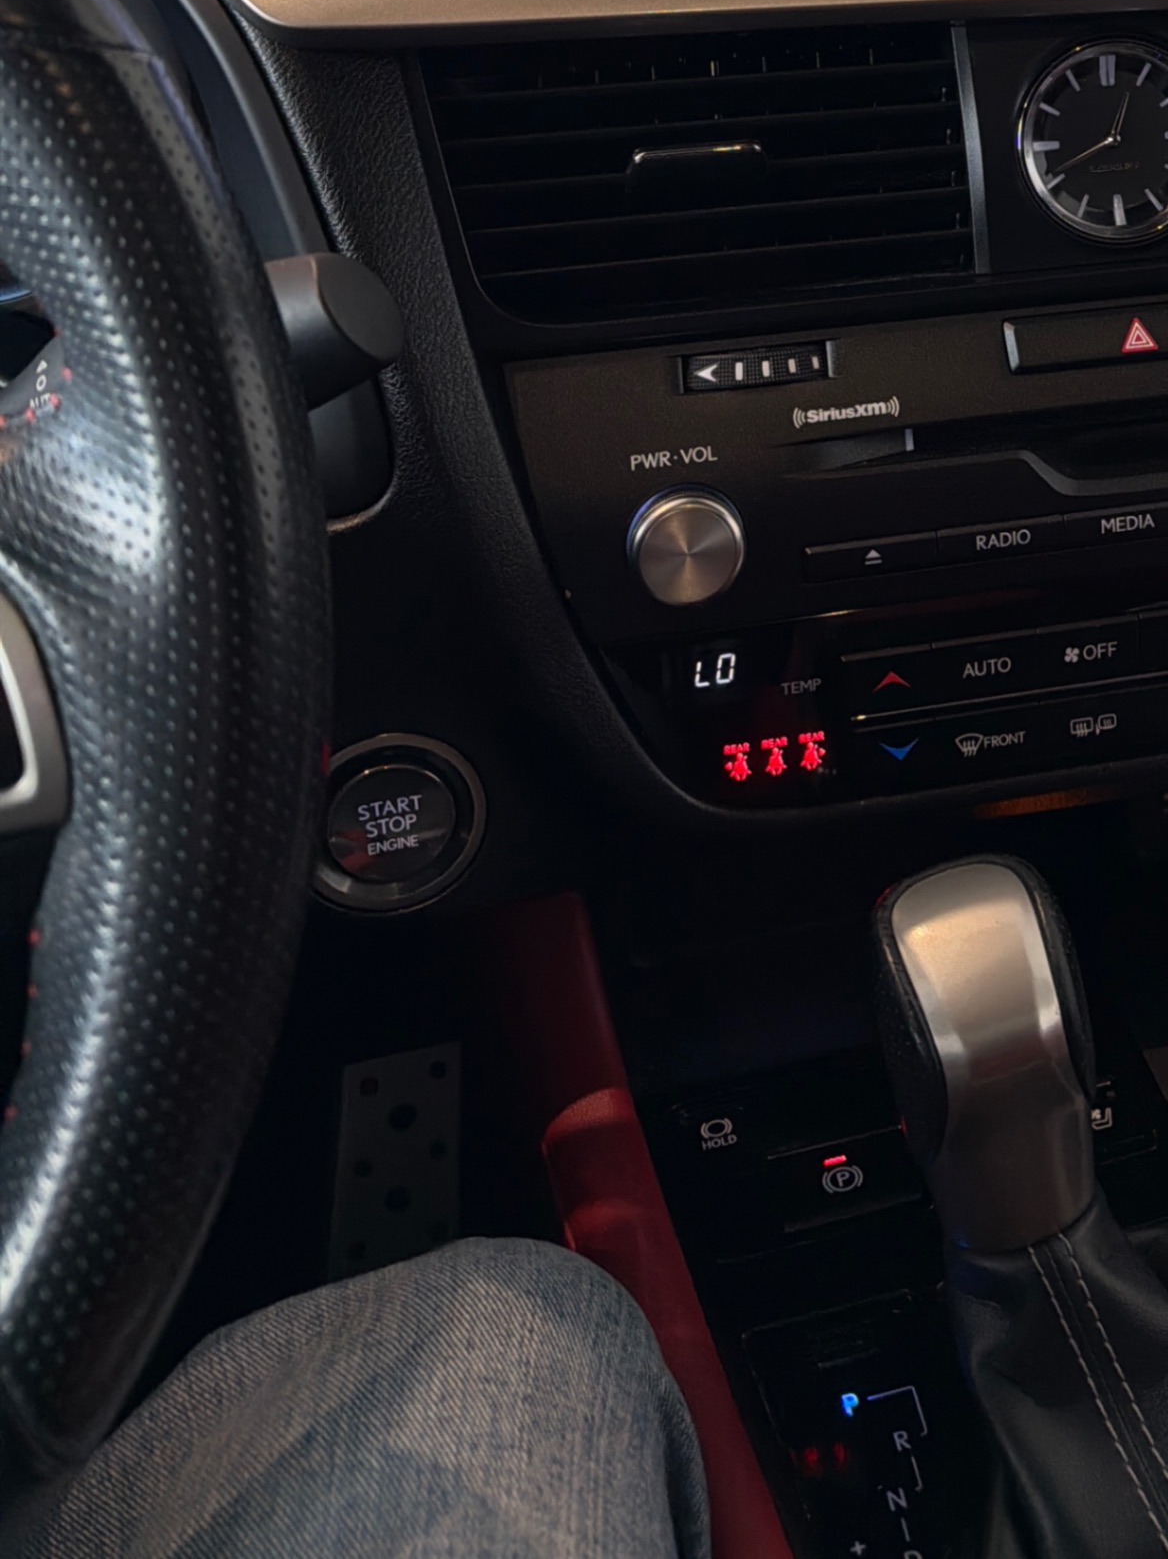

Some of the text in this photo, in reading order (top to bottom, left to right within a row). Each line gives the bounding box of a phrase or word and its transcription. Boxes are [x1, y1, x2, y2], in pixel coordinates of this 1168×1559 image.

[1100, 513, 1155, 535] MEDIA
[975, 528, 1032, 551] RADIO
[1082, 641, 1119, 661] OFF
[962, 656, 1012, 679] AUTO
[781, 678, 822, 696] TEMP
[761, 736, 788, 750] REAR
[798, 730, 825, 744] REAR
[983, 730, 1026, 750] FRONT
[723, 742, 750, 756] REAR
[357, 794, 422, 821] START
[365, 813, 417, 838] STOP
[367, 834, 420, 856] ENGINE
[701, 1134, 738, 1152] HOLD
[835, 1171, 850, 1188] P
[841, 1393, 859, 1417] P
[893, 1430, 911, 1452] R
[886, 1487, 907, 1512] N
